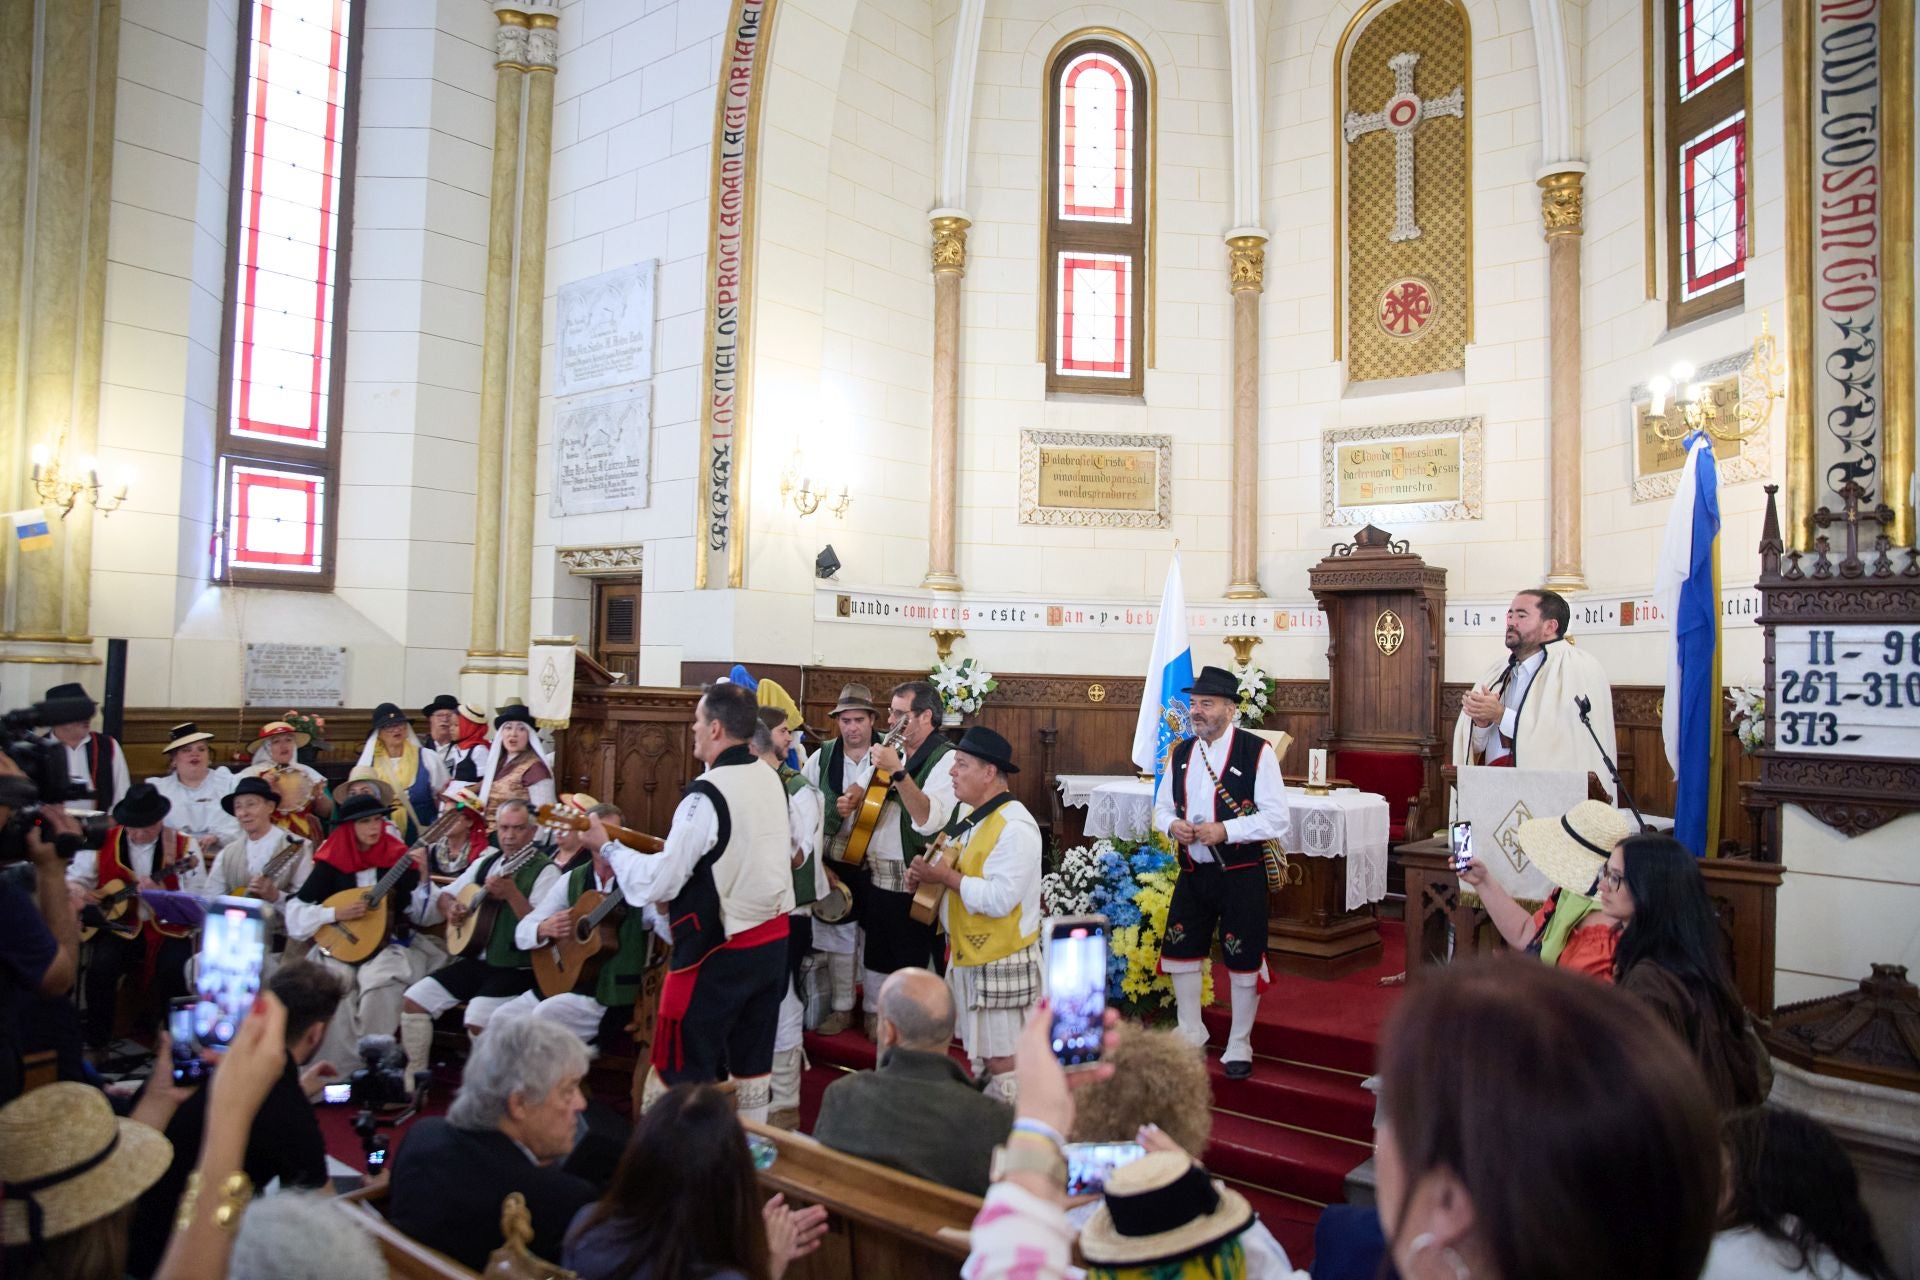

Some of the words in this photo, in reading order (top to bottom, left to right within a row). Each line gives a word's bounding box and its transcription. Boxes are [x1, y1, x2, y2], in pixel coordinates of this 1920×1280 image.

[712, 394, 734, 439] LOS
[723, 130, 745, 159] LA
[1821, 165, 1877, 312] SANTO
[837, 595, 890, 617] Cuando
[991, 607, 1026, 622] este
[1224, 611, 1256, 627] este
[1463, 609, 1481, 626] la
[1585, 605, 1604, 624] del
[1620, 600, 1665, 627] Seño
